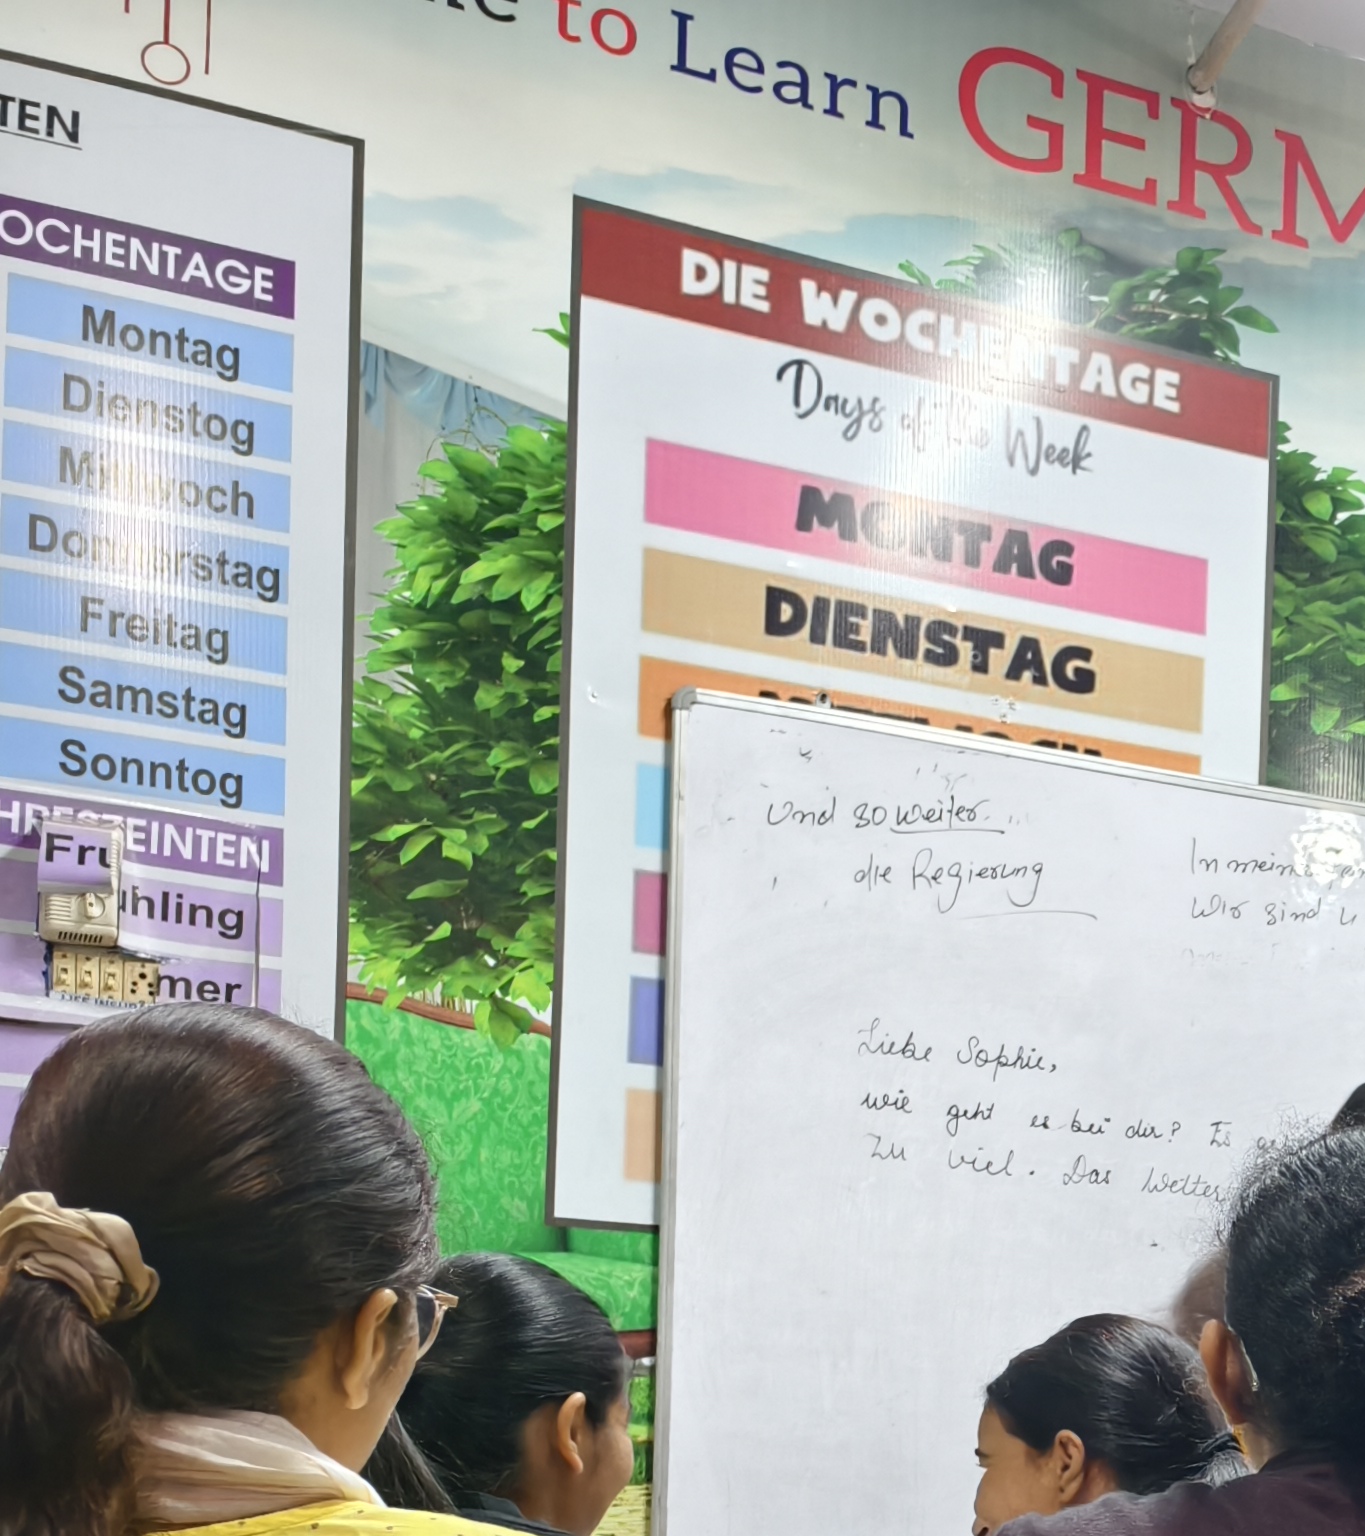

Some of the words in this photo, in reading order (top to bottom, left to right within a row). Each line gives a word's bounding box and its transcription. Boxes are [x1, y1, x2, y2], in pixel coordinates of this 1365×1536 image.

[556, 0, 637, 56] to
[670, 9, 914, 140] Learn
[680, 247, 770, 313] DIE
[80, 304, 241, 382] Montag
[1004, 404, 1094, 477] Week
[794, 484, 1076, 587] MONTAG
[80, 595, 229, 665] Freitag
[764, 585, 1097, 695] DIENSTAG
[57, 665, 247, 739] Samstag
